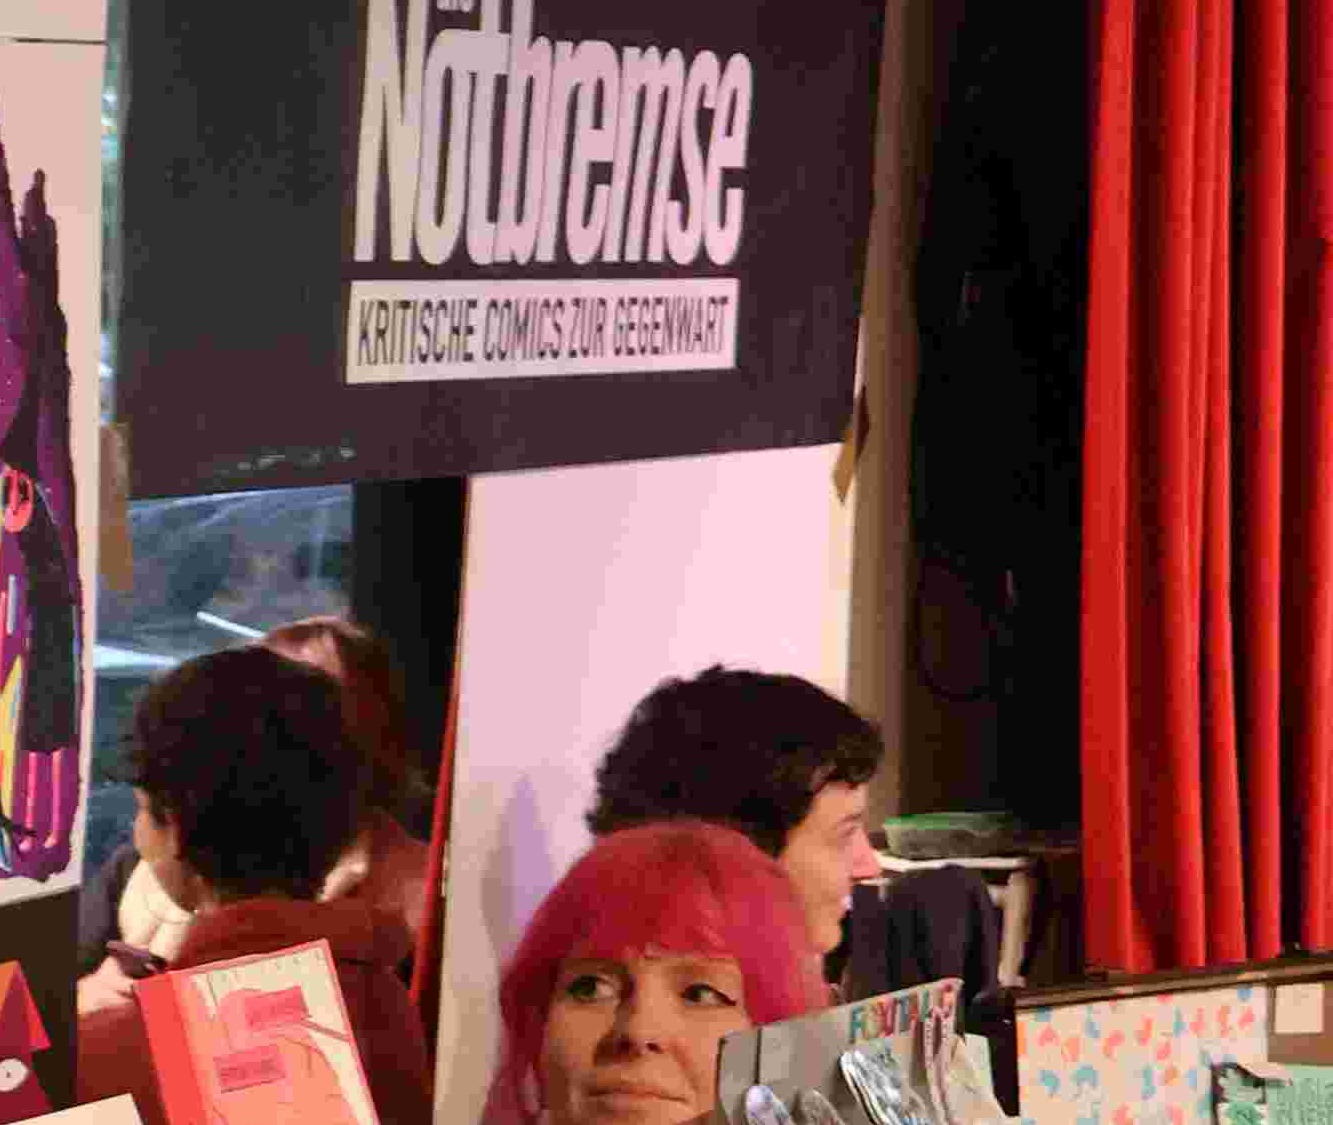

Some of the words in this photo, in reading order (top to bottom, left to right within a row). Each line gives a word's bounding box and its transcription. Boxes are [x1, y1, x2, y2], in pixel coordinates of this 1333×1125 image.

[356, 299, 477, 367] KRITISCHE
[483, 299, 565, 362] COMICS
[568, 298, 608, 359] ZUR
[611, 296, 729, 357] GEGENWART
